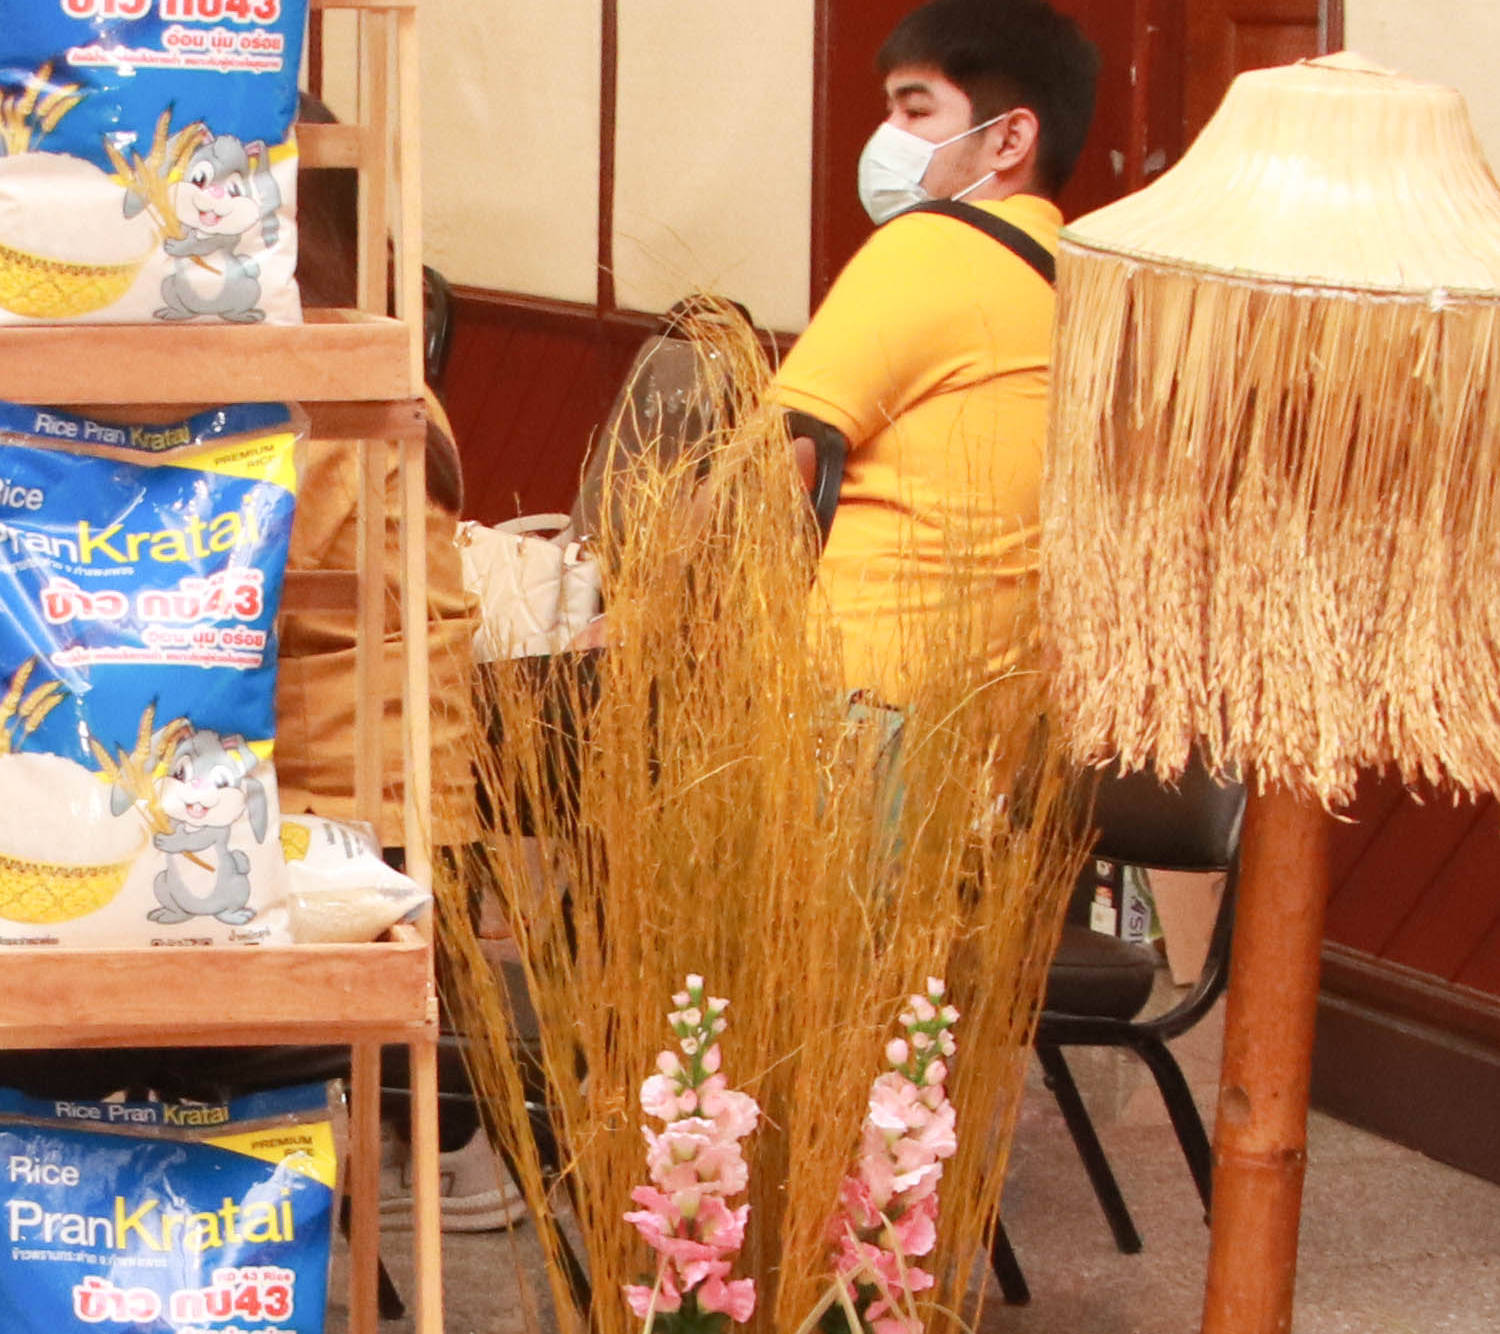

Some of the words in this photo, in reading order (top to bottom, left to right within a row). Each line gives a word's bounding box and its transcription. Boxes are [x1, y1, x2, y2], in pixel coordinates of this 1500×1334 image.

[166, 28, 204, 47] อ่อน
[210, 30, 234, 52] นุ่ม
[239, 30, 282, 50] อร่อย
[34, 413, 78, 438] Rice
[83, 422, 125, 445] Pran
[45, 578, 124, 620] ข้าว
[142, 584, 261, 619] กข43
[222, 627, 265, 649] อร่อย
[55, 1101, 101, 1120] Rice
[108, 1104, 157, 1123] Pran
[162, 1103, 230, 1126] Kratai
[250, 1134, 314, 1149] PREMIUM
[7, 1154, 81, 1187] Rice
[7, 1187, 295, 1253] PranKratai
[79, 1279, 157, 1319] ข้าว
[175, 1285, 290, 1318] กข43
